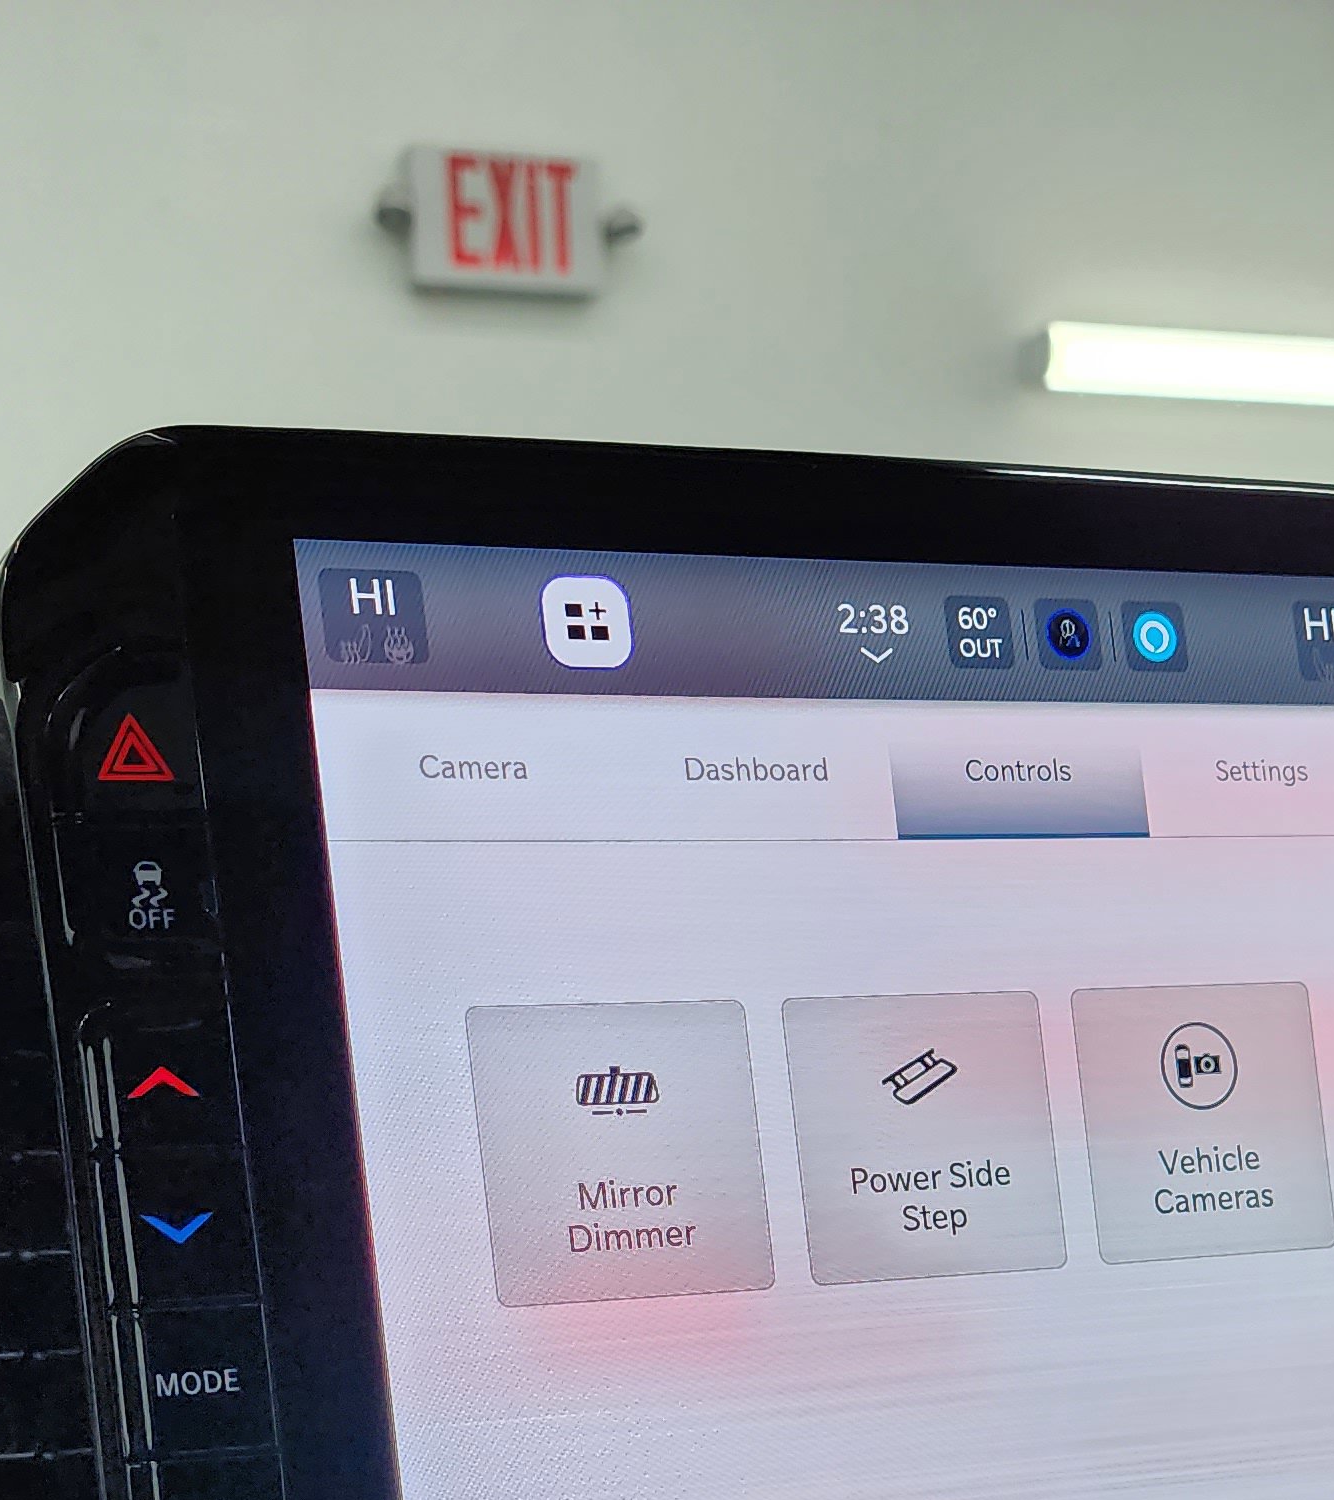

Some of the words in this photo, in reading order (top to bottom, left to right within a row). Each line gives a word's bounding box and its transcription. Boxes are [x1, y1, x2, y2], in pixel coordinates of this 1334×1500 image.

[446, 153, 577, 274] EXIT
[349, 577, 396, 616] HI
[836, 603, 910, 636] 2:38
[959, 639, 1003, 659] OUT
[418, 754, 529, 781] Camera
[683, 756, 830, 782] Dashboard
[964, 758, 1073, 783] Controls
[1214, 759, 1310, 787] Settings
[128, 908, 175, 930] OFF
[1157, 1144, 1262, 1177] Vehicle
[849, 1163, 941, 1196] Power
[948, 1161, 1012, 1190] Side
[576, 1179, 678, 1213] Mirror
[1153, 1185, 1275, 1216] Cameras
[901, 1203, 969, 1237] Step
[567, 1220, 697, 1254] Dimmer
[155, 1367, 241, 1398] MODE
